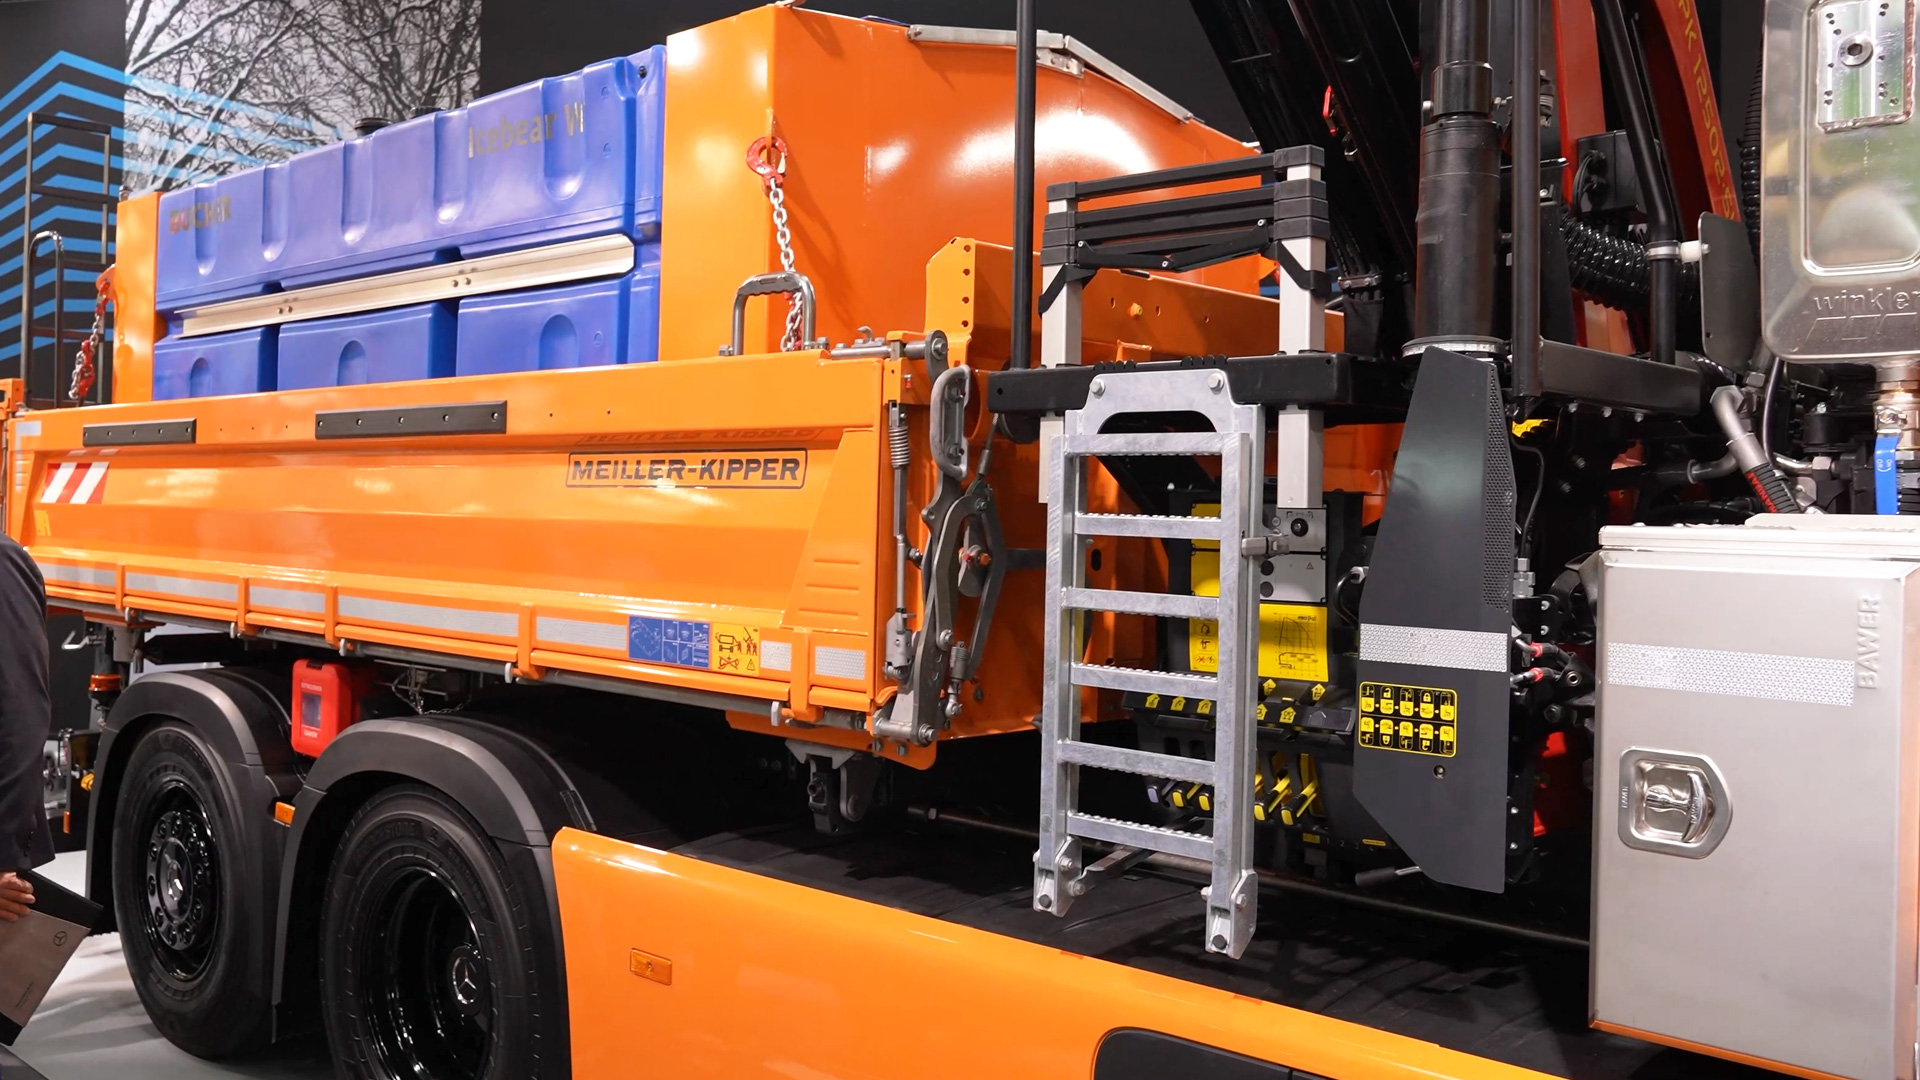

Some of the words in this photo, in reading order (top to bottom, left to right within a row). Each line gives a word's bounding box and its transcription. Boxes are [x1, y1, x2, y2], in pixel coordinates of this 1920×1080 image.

[468, 114, 557, 158] Icebear
[563, 101, 583, 137] W
[571, 457, 801, 482] MEILLER-KIPPER
[1857, 597, 1880, 689] BAWER
